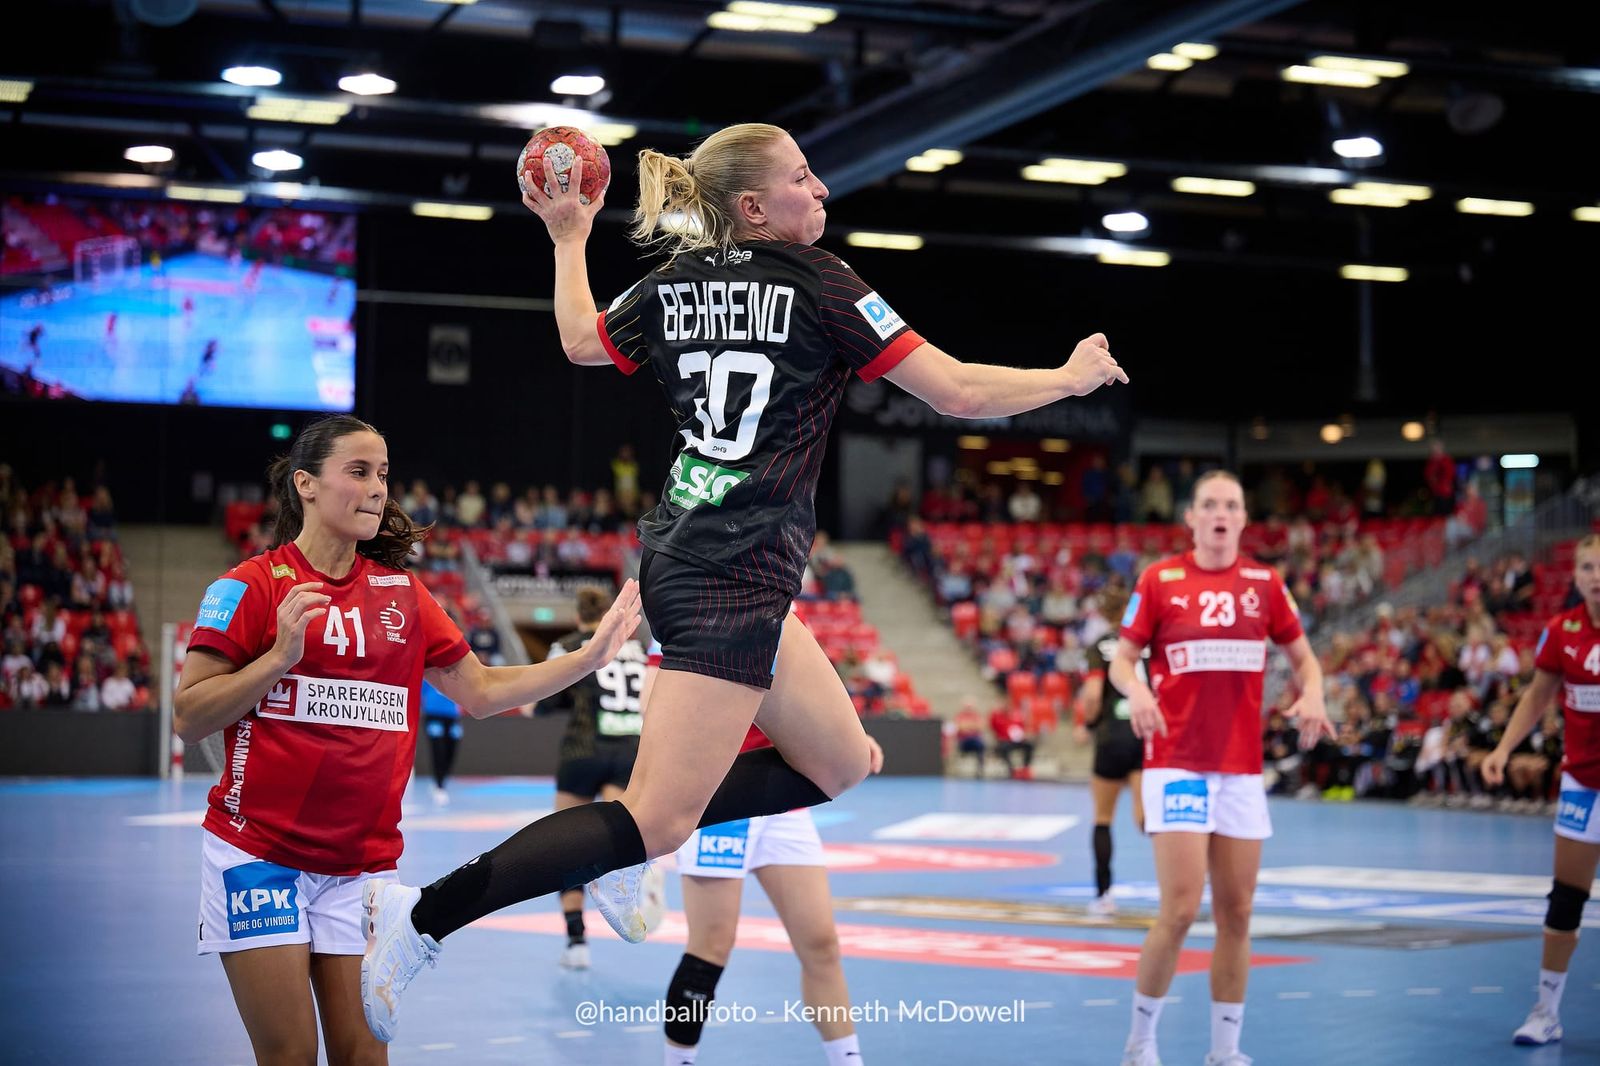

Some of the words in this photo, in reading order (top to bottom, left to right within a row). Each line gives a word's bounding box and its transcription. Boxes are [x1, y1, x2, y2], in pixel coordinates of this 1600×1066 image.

[657, 281, 795, 343] BEHREND
[677, 350, 775, 461] 30
[1198, 590, 1236, 627] 23
[323, 605, 366, 657] 41
[307, 683, 404, 708] SPAREKASSEN
[595, 660, 648, 712] 93
[307, 701, 404, 726] KRONJYLLAND
[1165, 793, 1208, 813] KPK
[701, 836, 744, 855] KPK
[231, 888, 292, 915] KPK
[252, 918, 262, 928] OG
[264, 915, 295, 927] VINDUER
